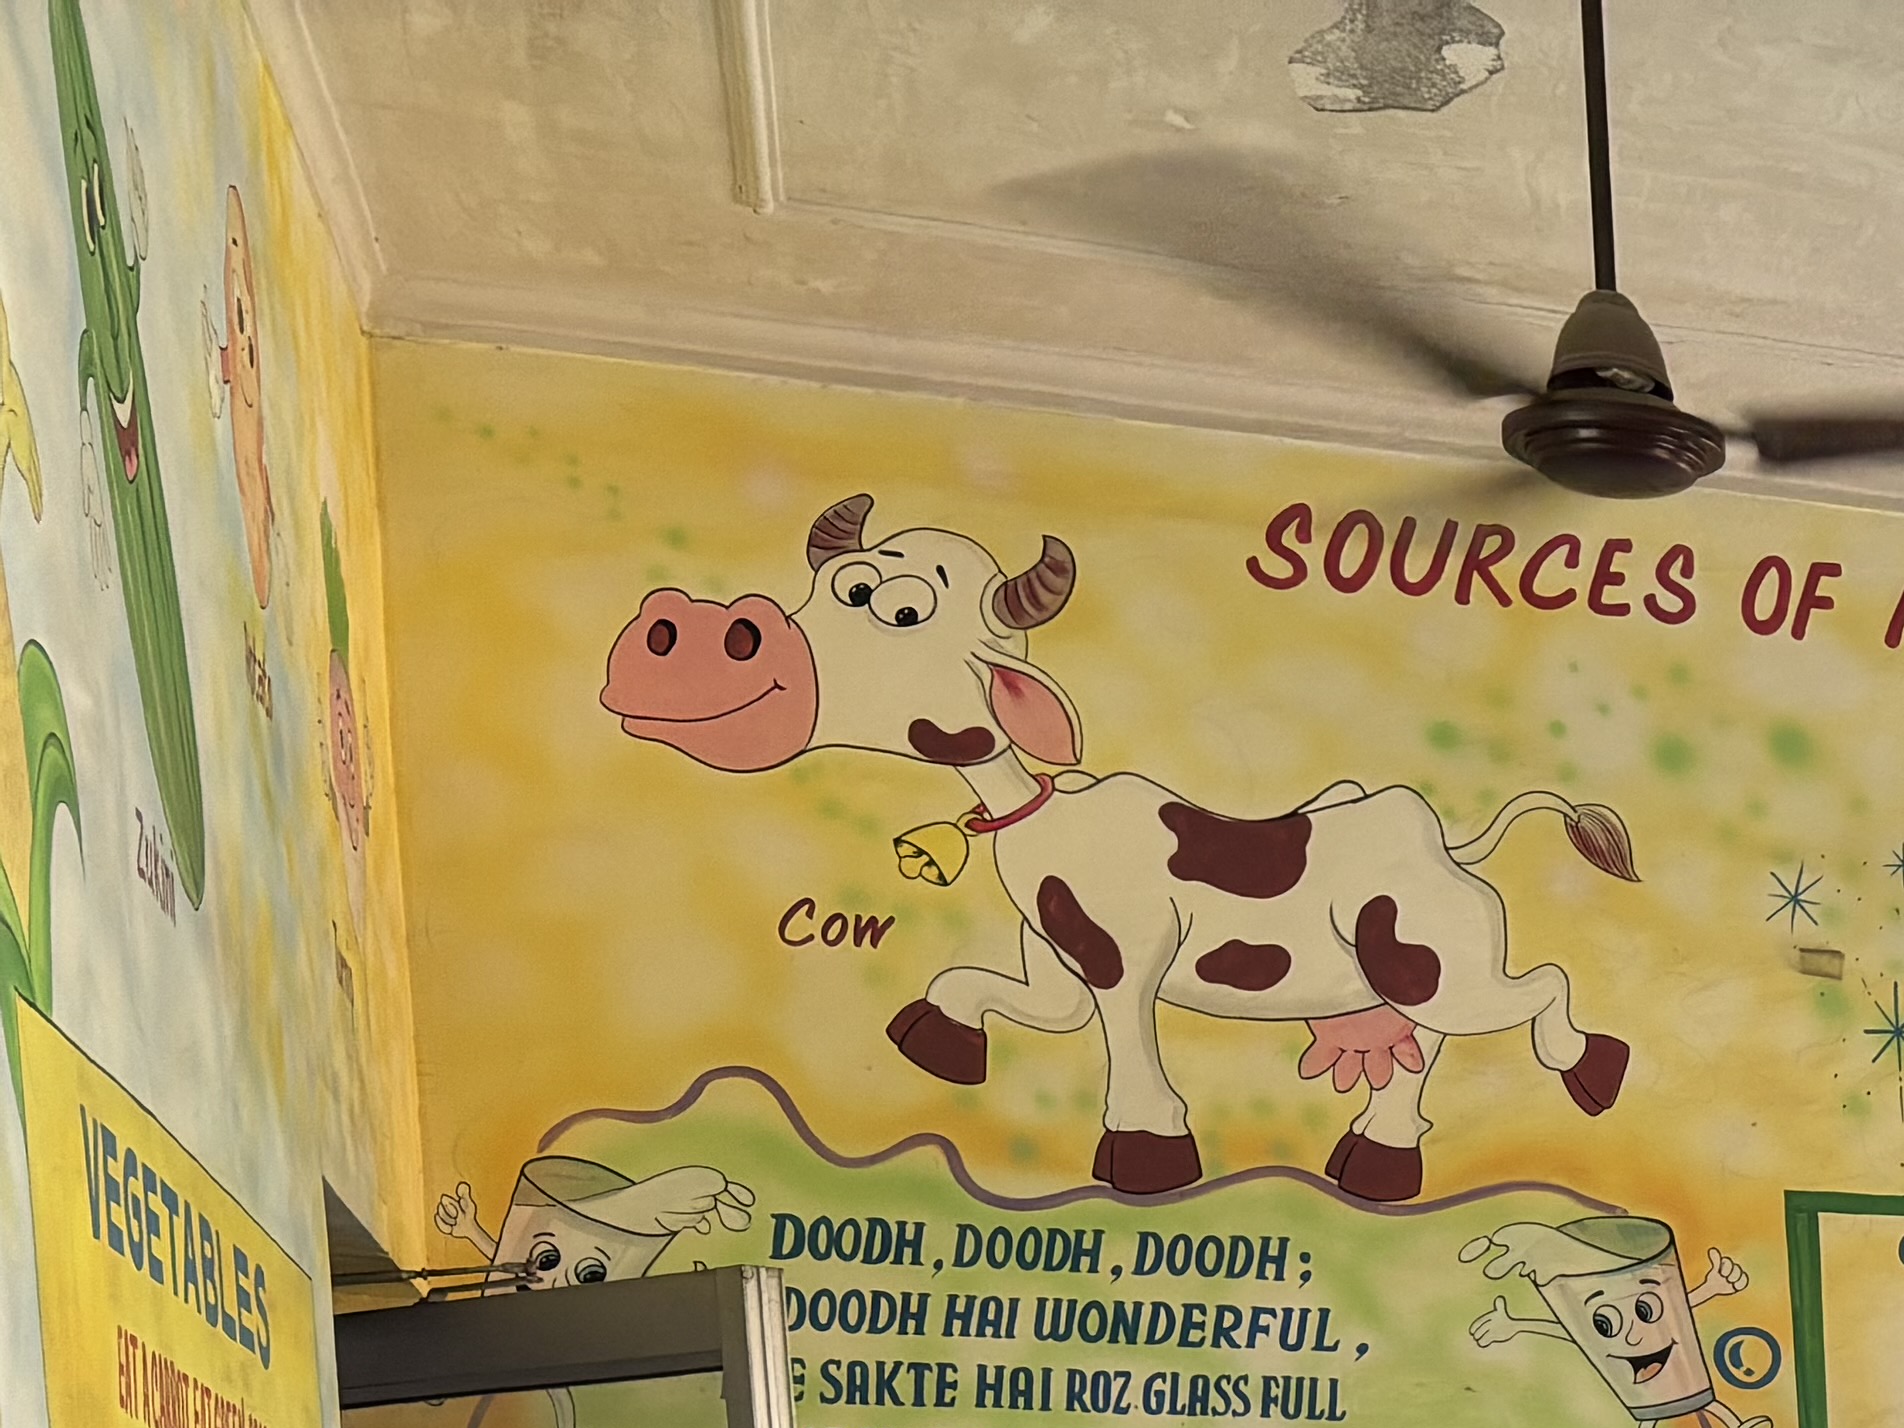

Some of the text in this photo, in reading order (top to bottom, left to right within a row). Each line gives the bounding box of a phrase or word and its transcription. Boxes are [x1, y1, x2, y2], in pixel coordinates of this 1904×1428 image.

[1245, 502, 1698, 625] SOURCES
[1741, 554, 1842, 641] OF
[778, 897, 895, 949] Cow
[79, 1103, 272, 1371] VEGETABLES
[786, 1286, 931, 1337] DOODH
[942, 1294, 1018, 1340] HAI
[117, 1325, 138, 1419] EAT
[142, 1341, 151, 1428] A
[820, 1359, 959, 1408] SAKTE
[974, 1365, 1053, 1412] HAI
[1065, 1369, 1132, 1415] ROZ
[1143, 1373, 1251, 1419] GLASS
[1260, 1373, 1346, 1421] FULL
